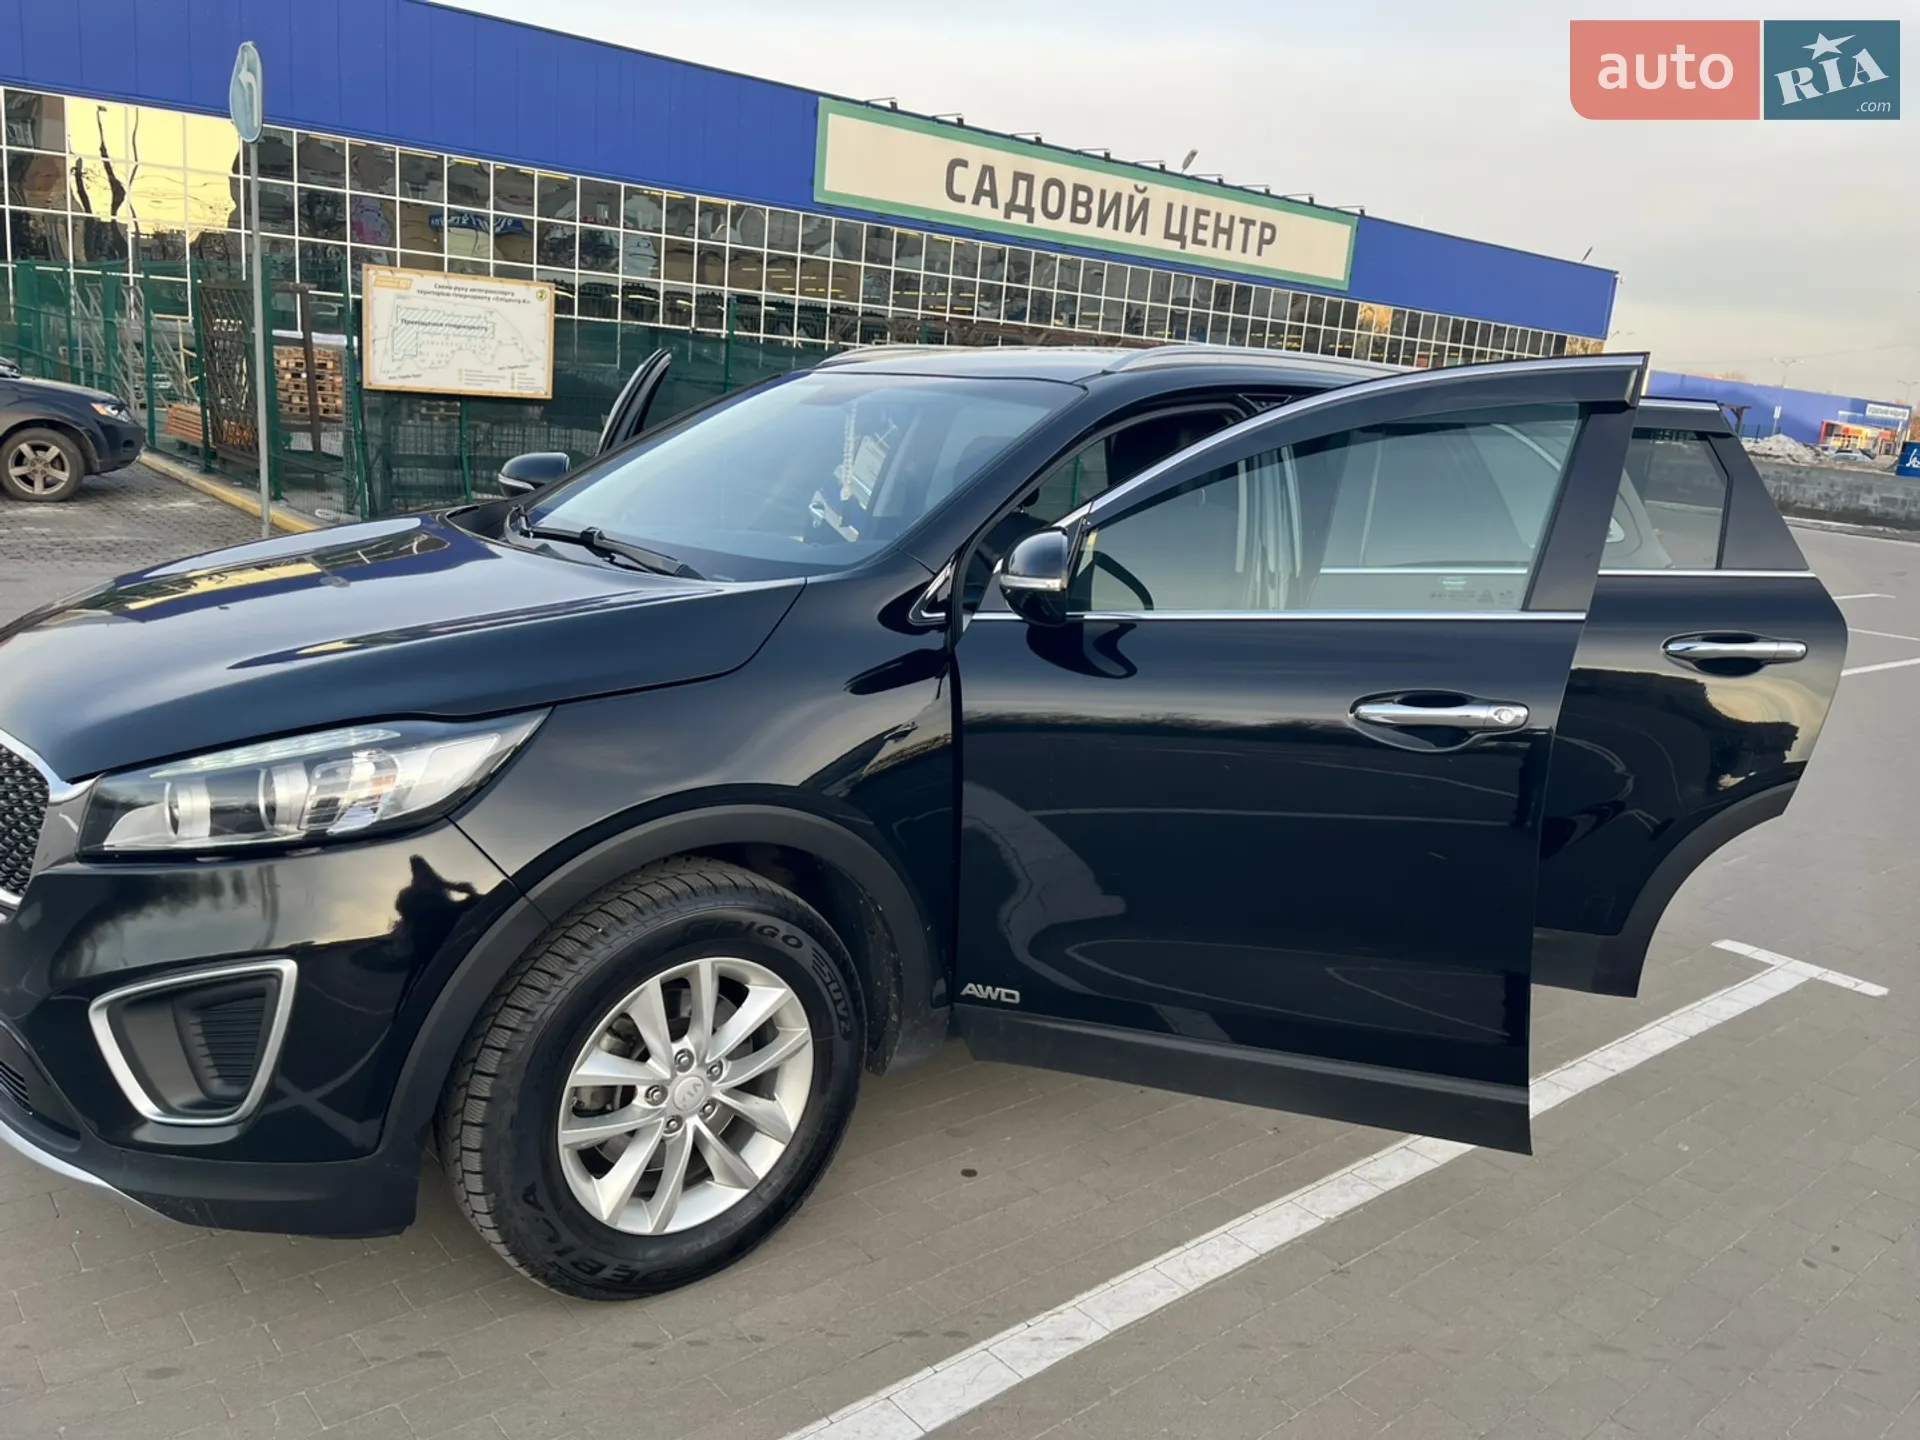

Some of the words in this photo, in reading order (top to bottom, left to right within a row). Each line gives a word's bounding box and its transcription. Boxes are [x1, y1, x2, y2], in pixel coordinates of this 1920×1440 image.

[945, 157, 1150, 236] САДОВИЙ
[1162, 201, 1277, 257] ЦЕНТР
[959, 982, 1021, 1004] AWD
